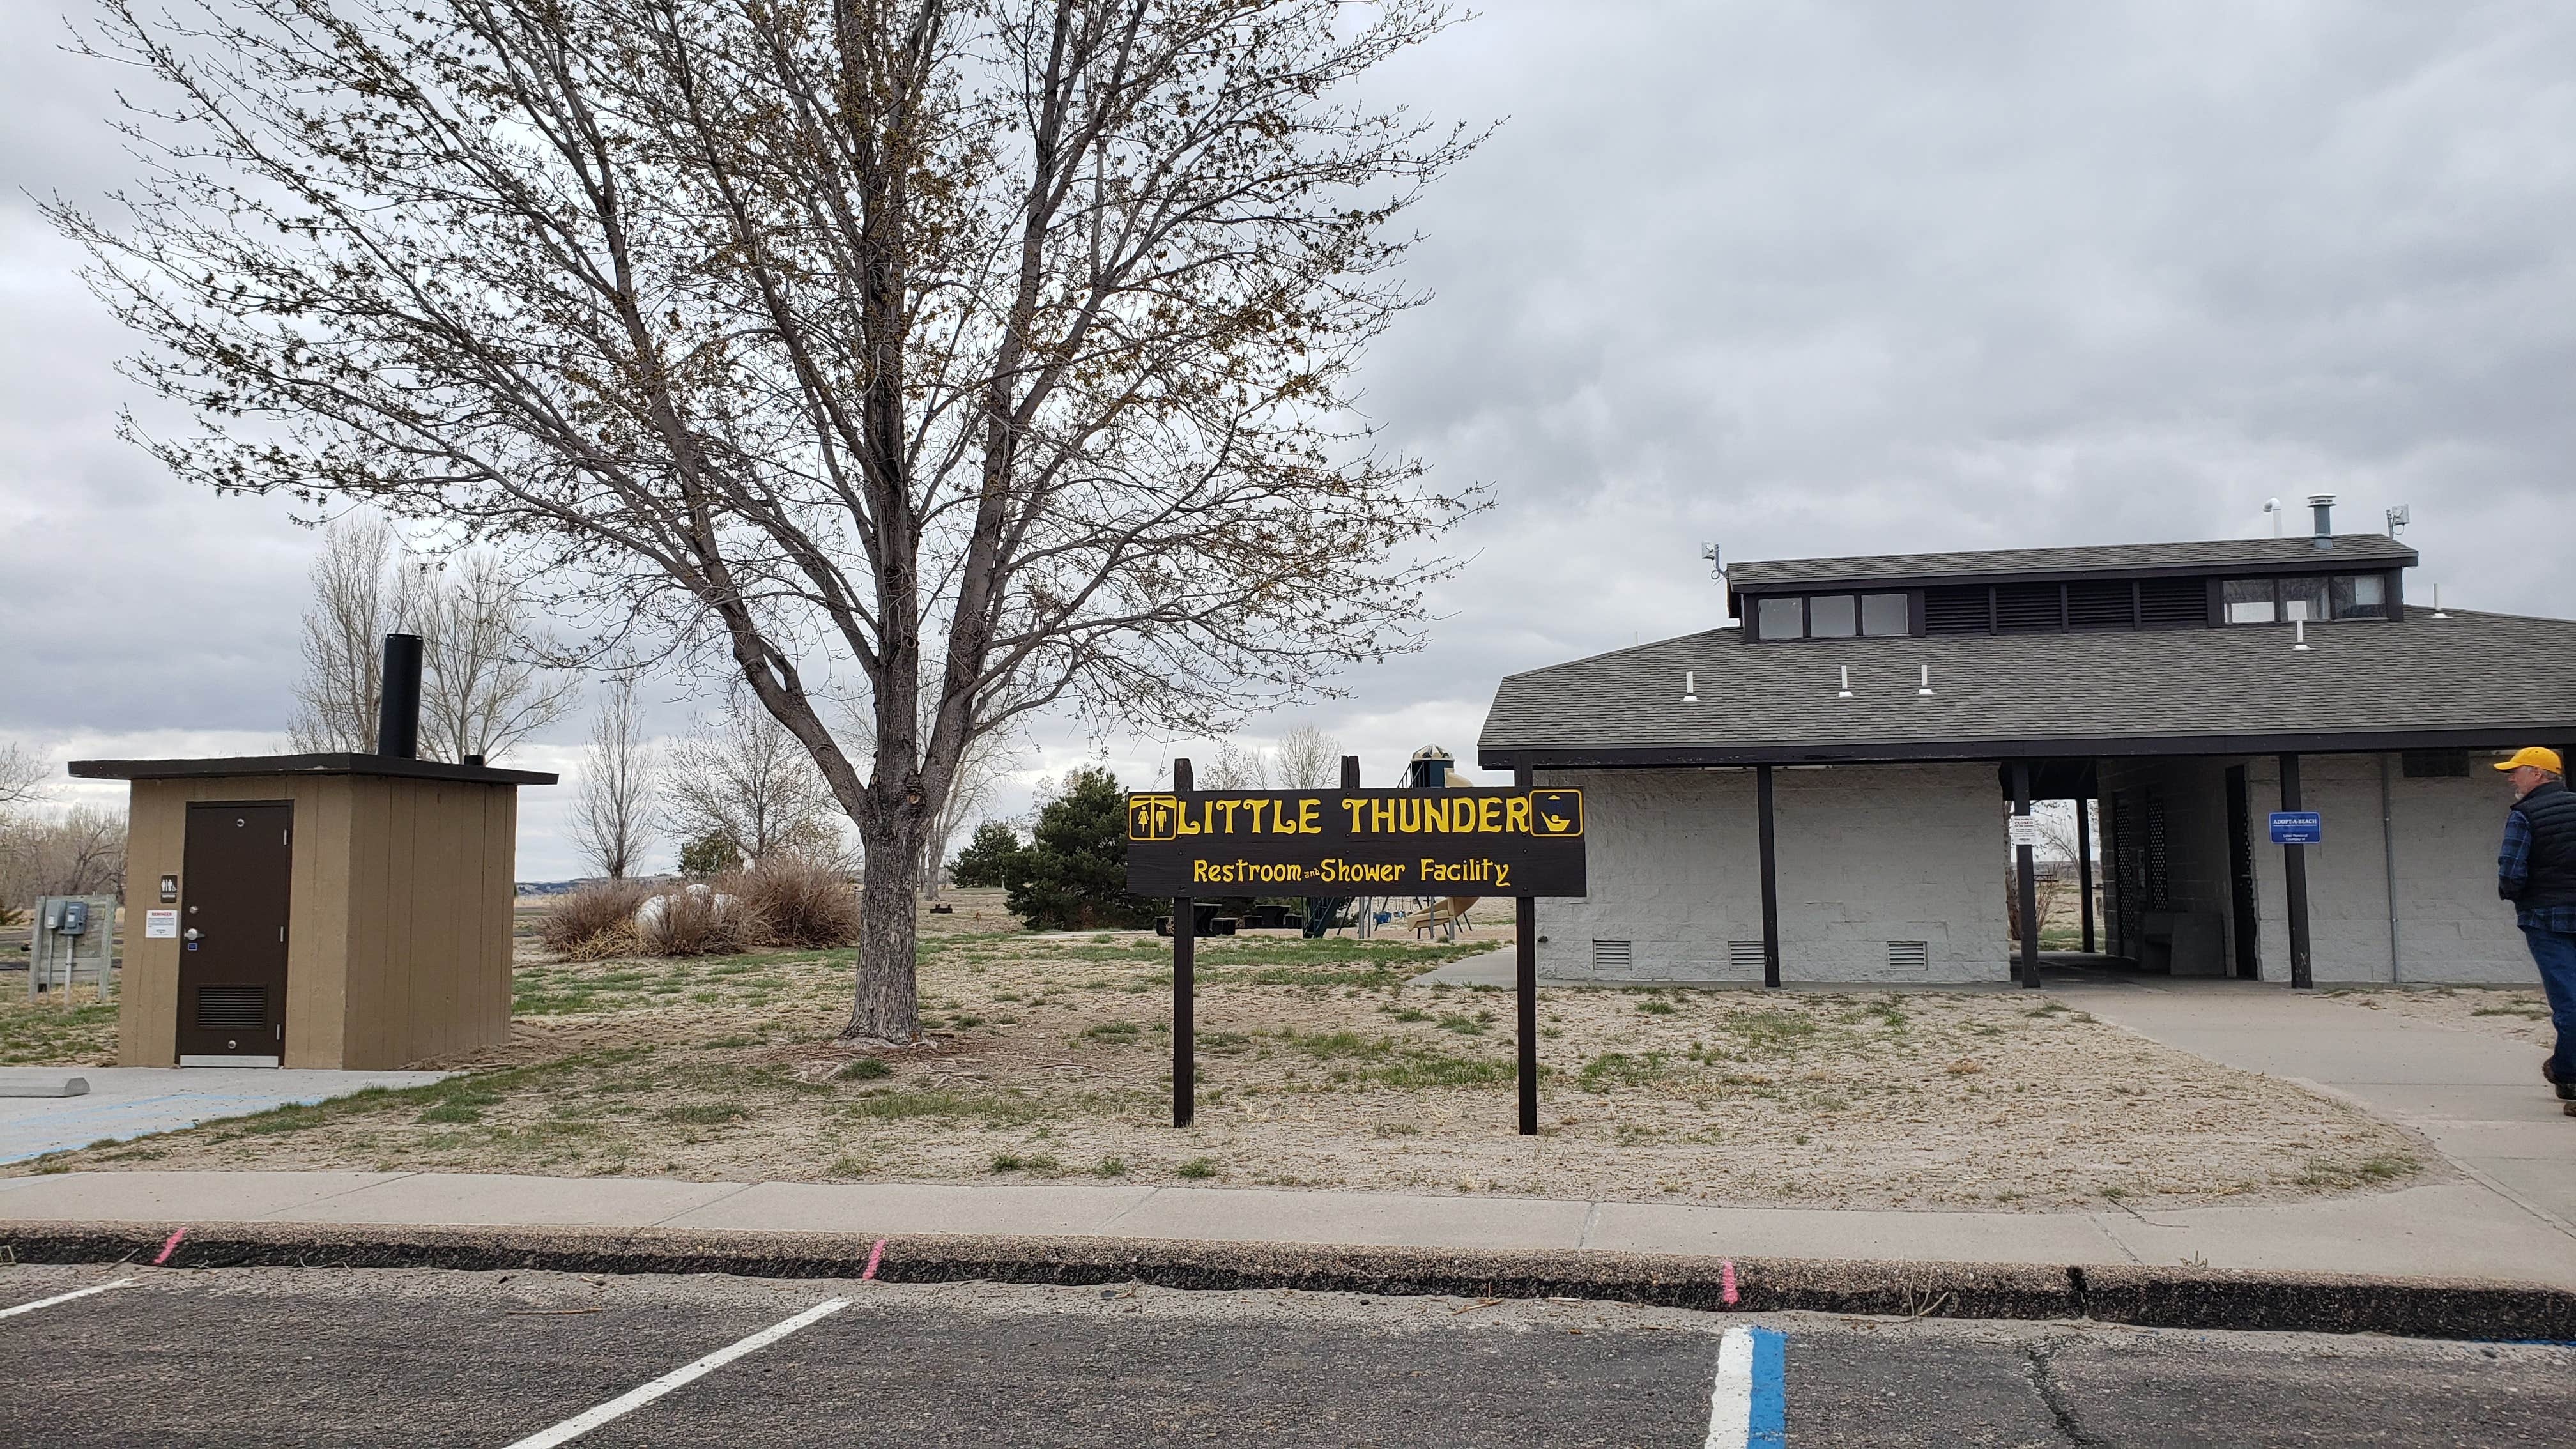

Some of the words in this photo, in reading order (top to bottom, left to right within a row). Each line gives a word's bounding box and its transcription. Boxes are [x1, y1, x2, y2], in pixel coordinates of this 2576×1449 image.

[1177, 798, 1322, 834] LITTLE
[1341, 795, 1530, 833] THUNDER
[1193, 859, 1302, 882] Restroom
[1303, 868, 1321, 878] and
[1321, 858, 1406, 882] Shower
[1420, 858, 1511, 887] Facility
